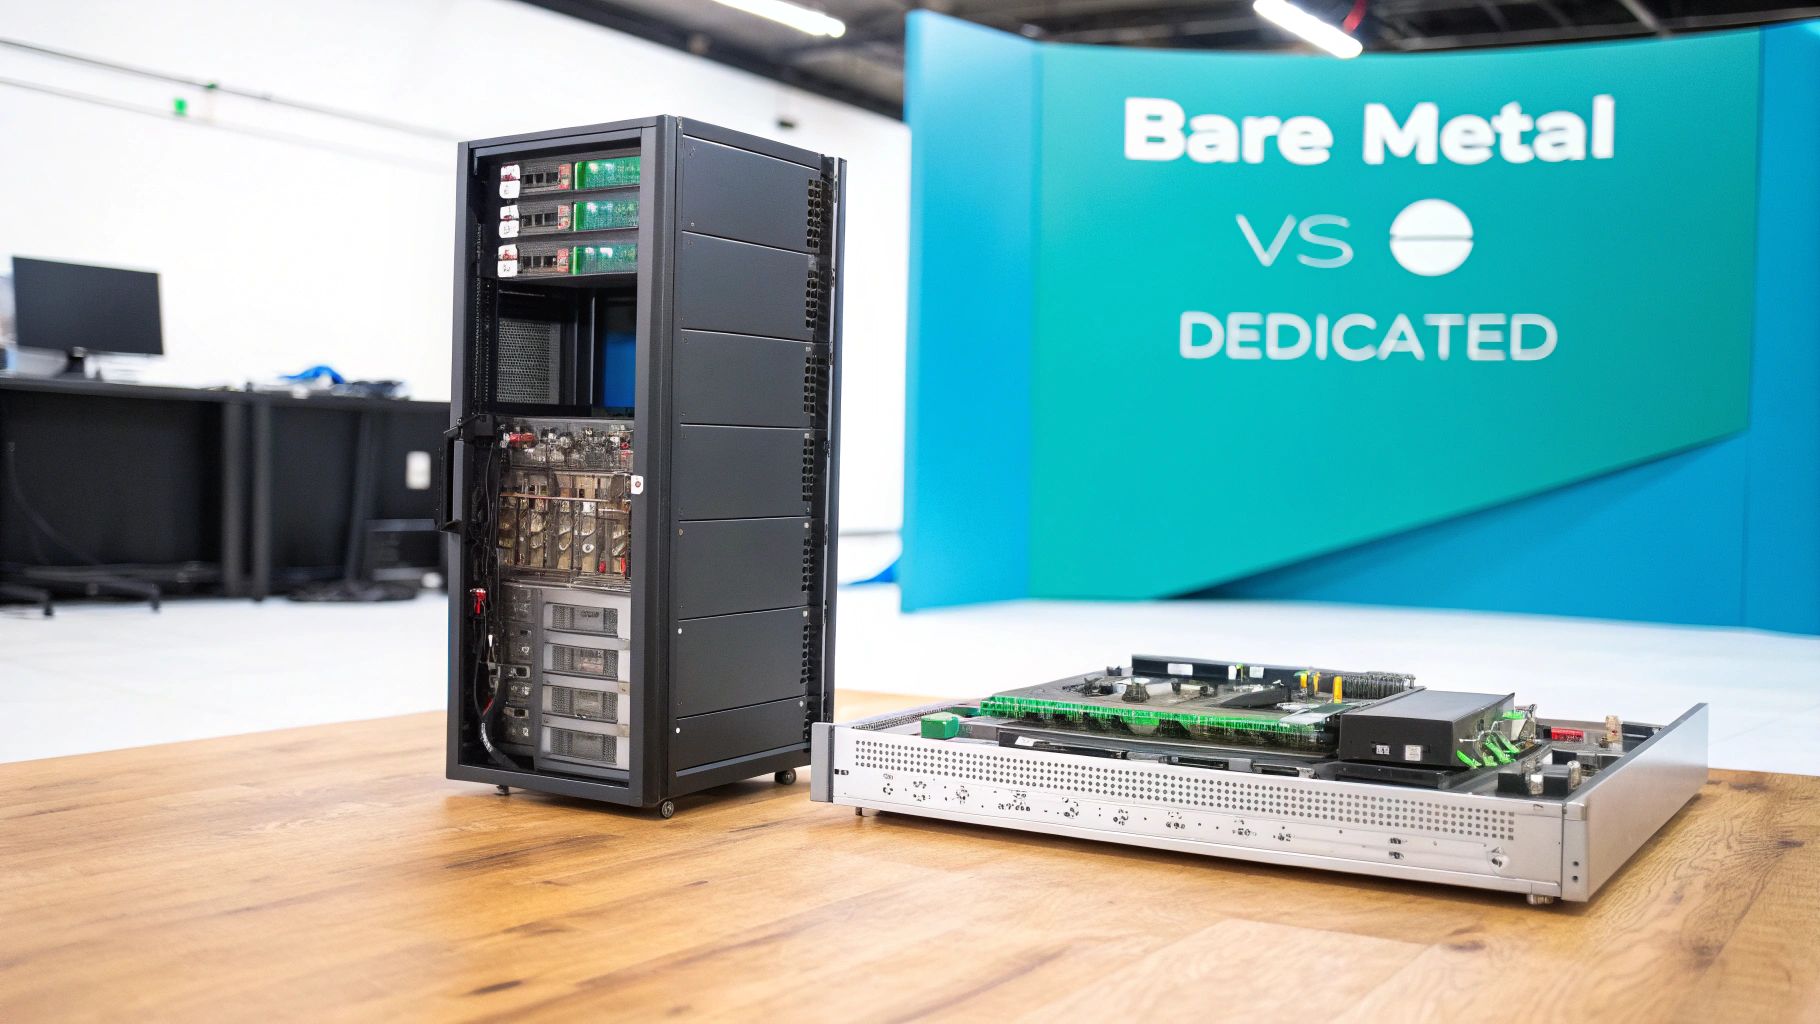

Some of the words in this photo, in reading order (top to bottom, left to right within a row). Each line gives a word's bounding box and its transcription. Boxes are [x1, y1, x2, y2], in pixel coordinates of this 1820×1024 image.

[1124, 97, 1333, 165] Bare
[1363, 94, 1615, 165] Metal
[1236, 214, 1354, 269] VS
[1180, 312, 1558, 362] DEDICATED
